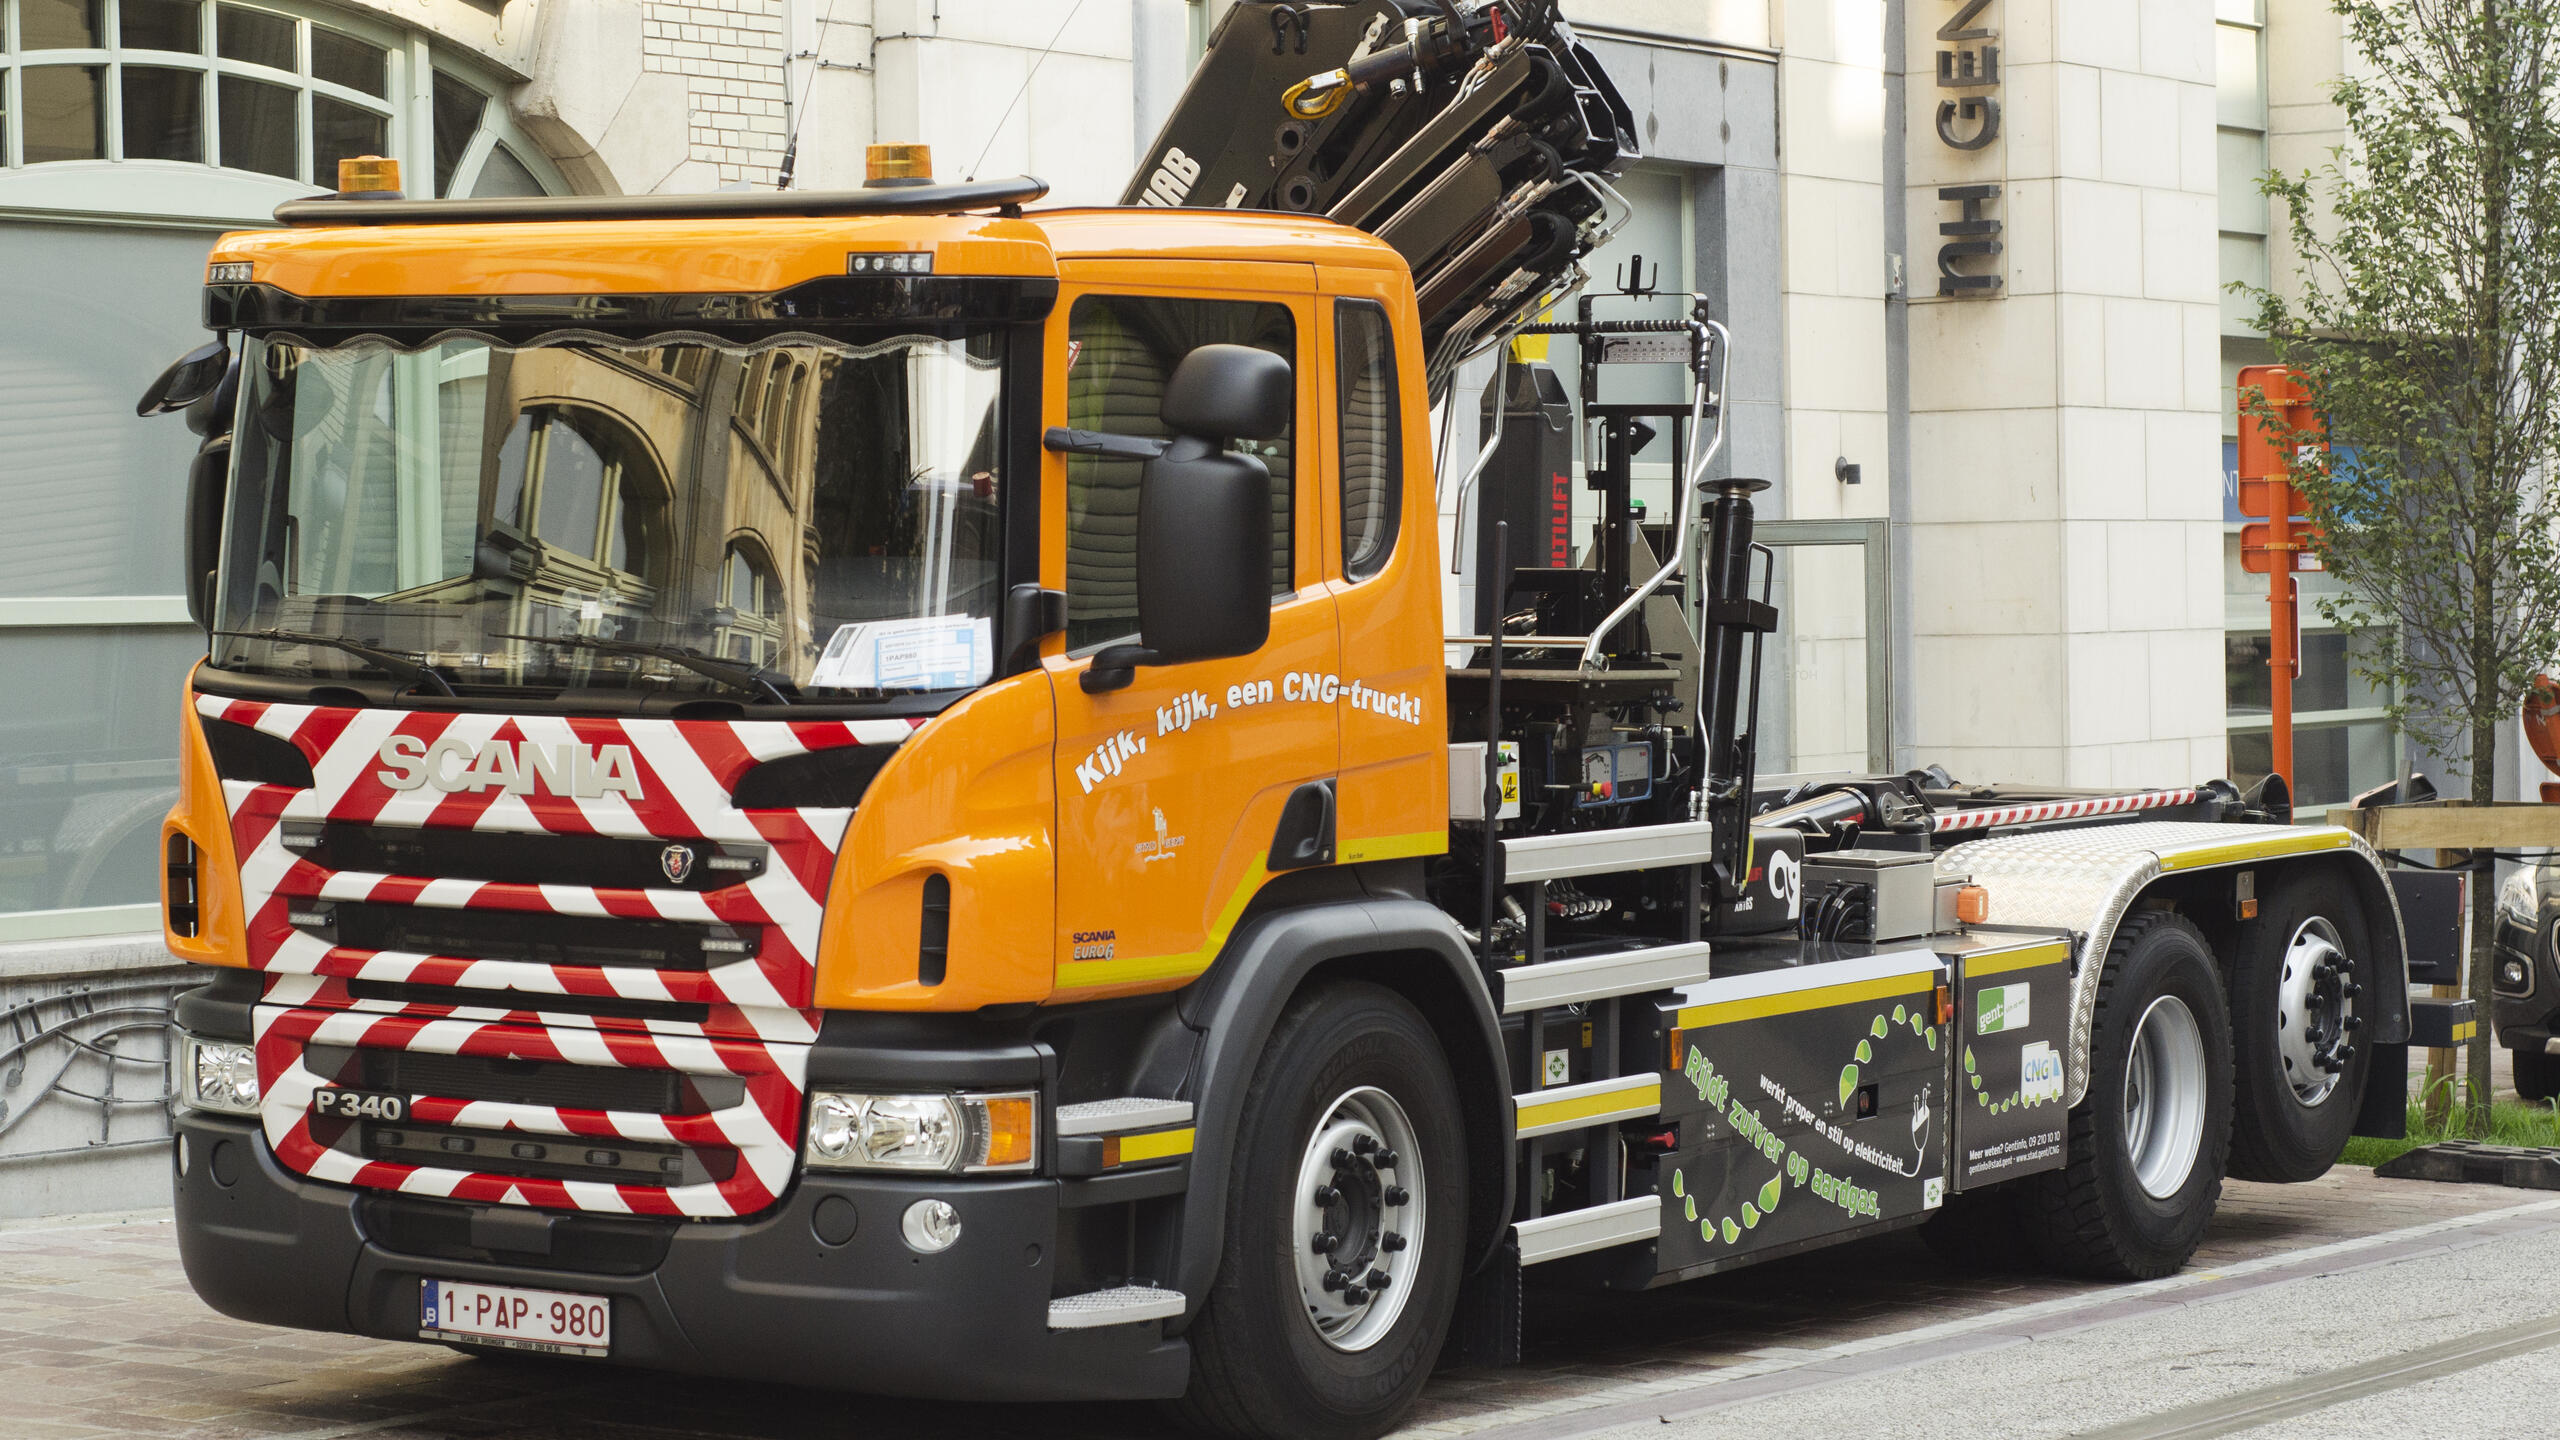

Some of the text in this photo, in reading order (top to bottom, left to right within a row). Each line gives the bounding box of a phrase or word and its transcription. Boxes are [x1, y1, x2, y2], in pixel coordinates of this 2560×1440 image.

[1136, 146, 1201, 207] IAB
[1075, 671, 1421, 795] Kijk, kijk, een CNG-truck!
[377, 735, 645, 800] SCANIA
[1072, 930, 1116, 944] SCANIA
[2025, 1058, 2049, 1082] CNG
[316, 1090, 402, 1120] P 340
[1760, 1074, 1903, 1174] werkt proper en stil op elektriciteit
[1685, 1044, 1880, 1220] Rijdt zuiver op aardgas,
[1969, 1130, 2061, 1160] Meer weten? Gentinfo, 09 210 10 10
[426, 1307, 436, 1323] B
[445, 1290, 605, 1338] 1-PAP-980
